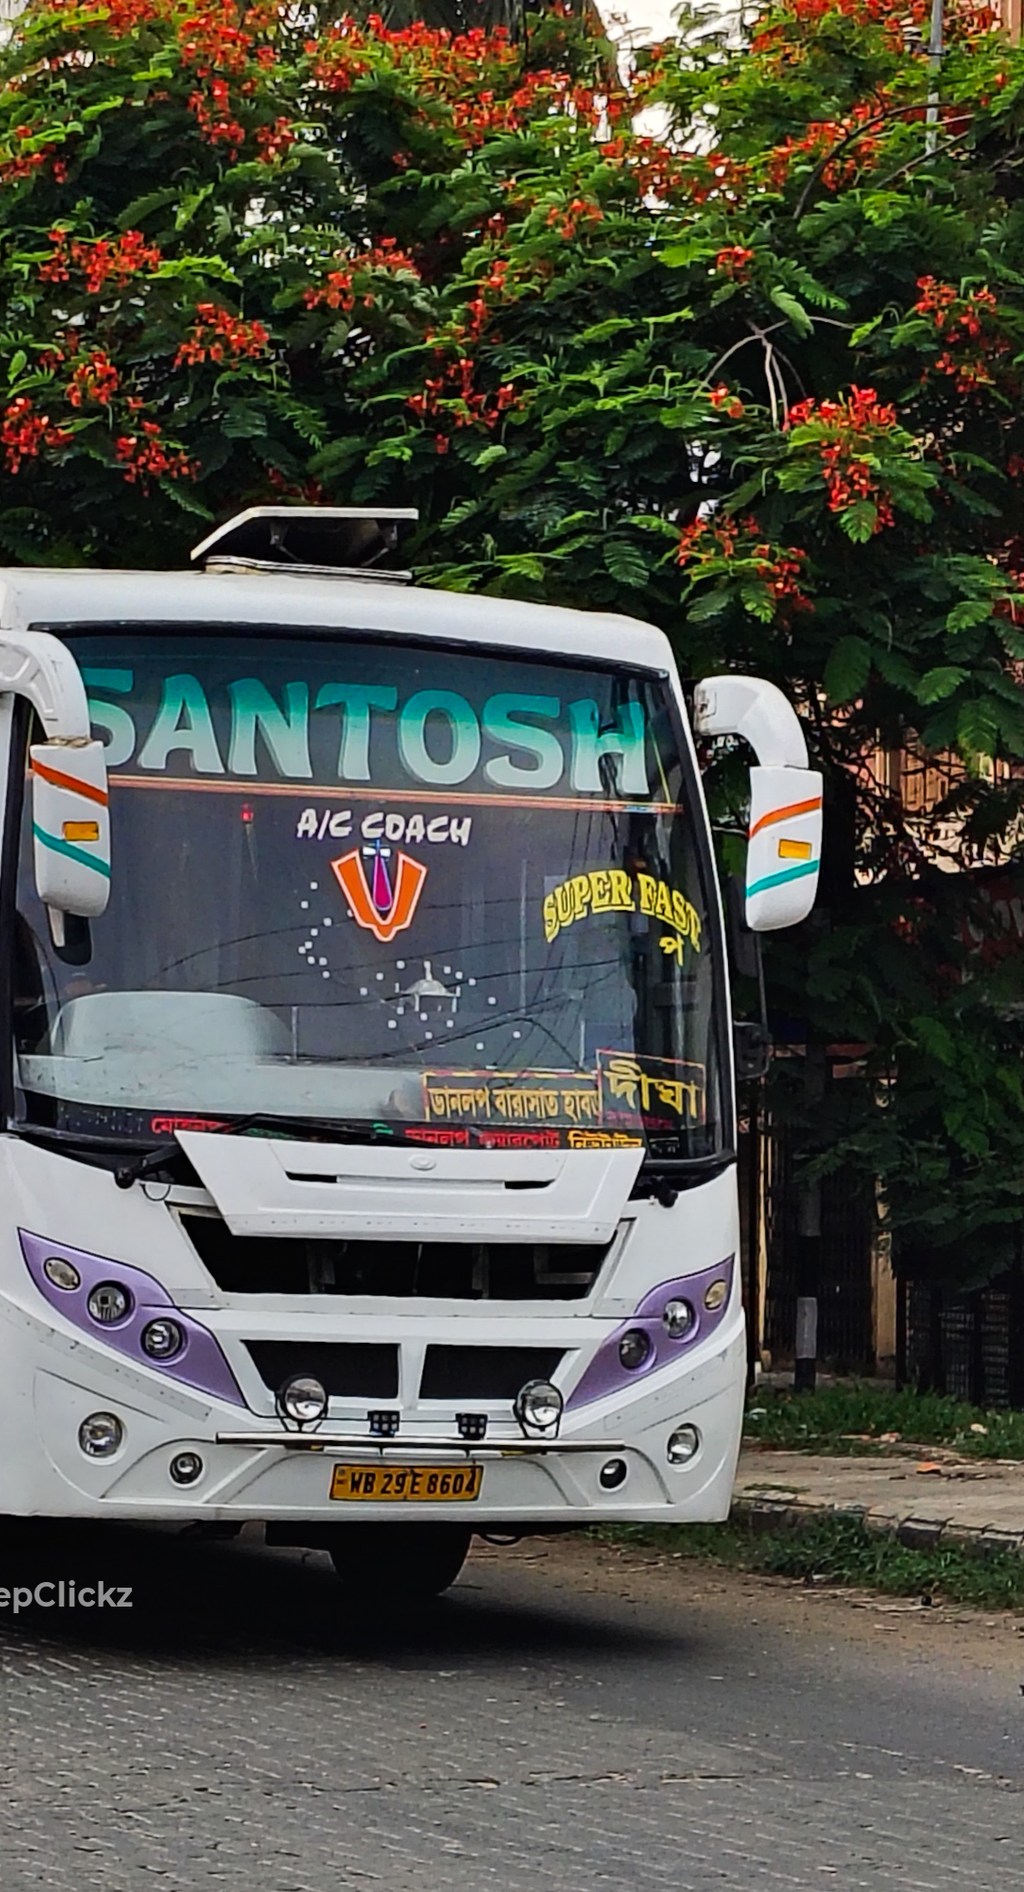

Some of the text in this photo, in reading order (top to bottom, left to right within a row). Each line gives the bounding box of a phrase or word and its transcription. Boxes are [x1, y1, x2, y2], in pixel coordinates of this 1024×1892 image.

[83, 668, 650, 794] SANTOSH
[296, 808, 473, 847] A/C COACH
[543, 869, 636, 944] SUPER
[637, 872, 702, 953] FAST
[350, 1471, 376, 1494] WB
